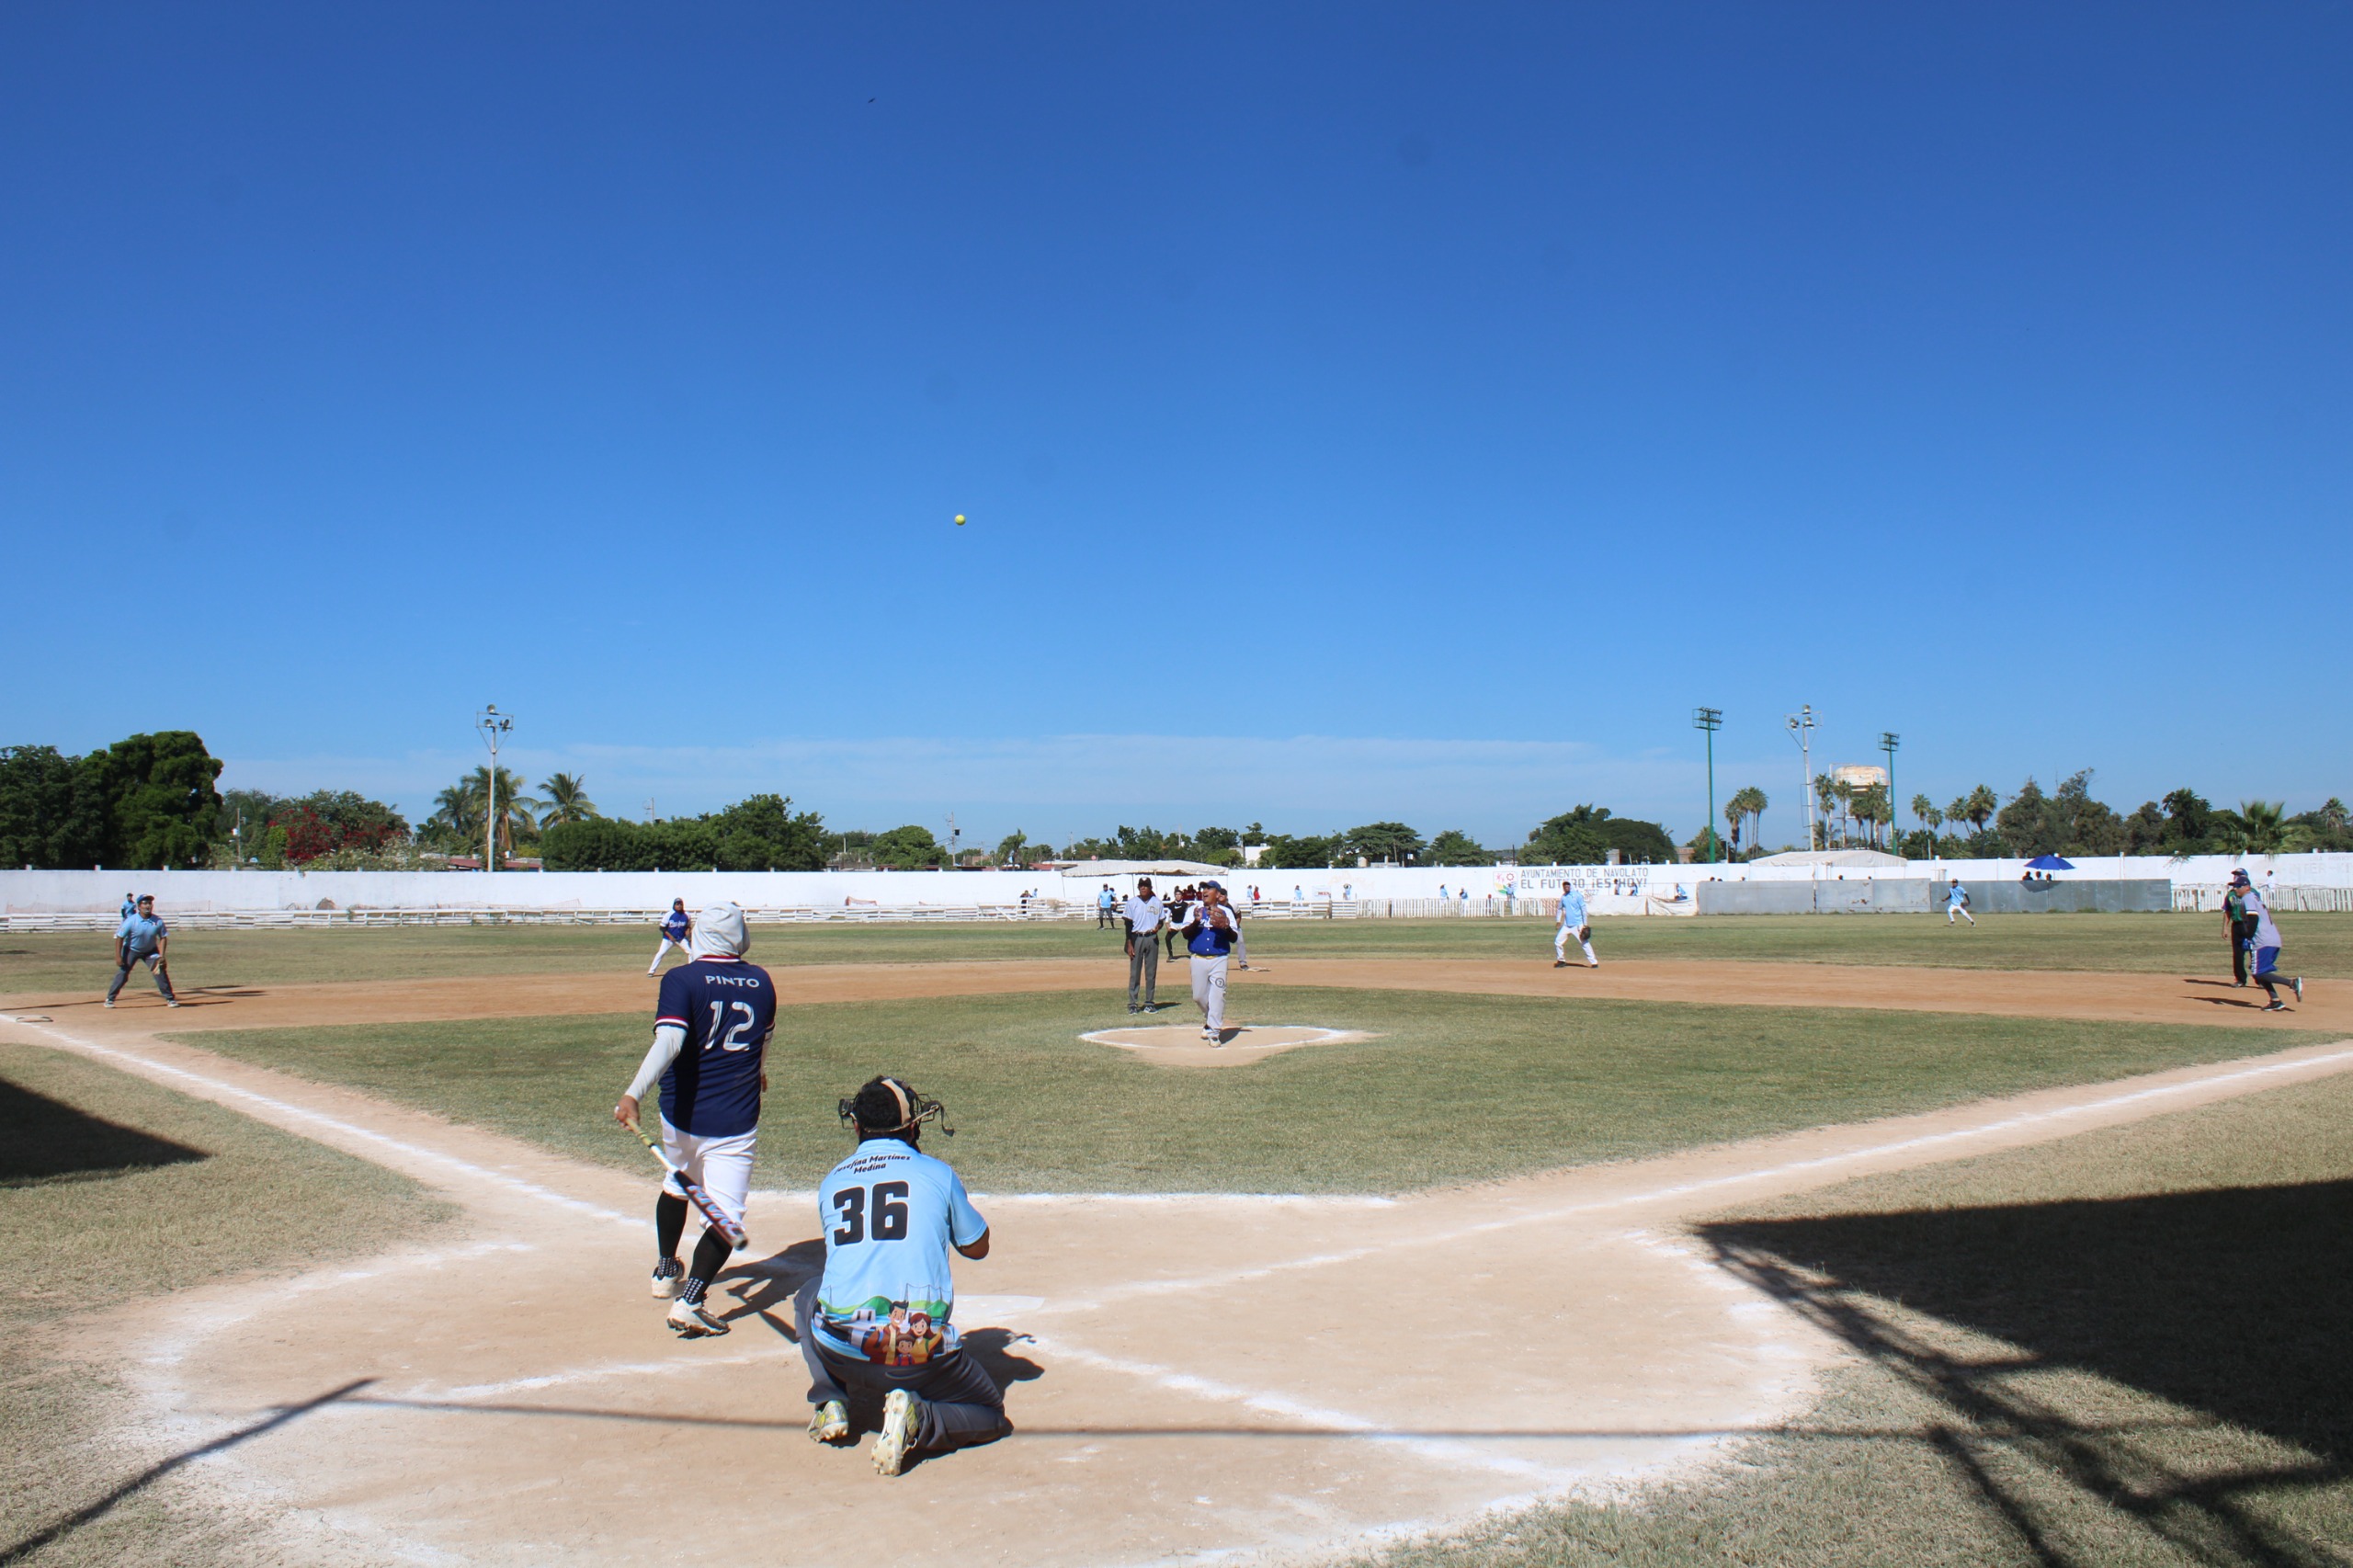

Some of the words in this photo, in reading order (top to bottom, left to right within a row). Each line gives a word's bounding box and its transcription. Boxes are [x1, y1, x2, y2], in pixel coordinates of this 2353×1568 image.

[1520, 869, 1581, 878] AYUNTAMIENTO
[1586, 869, 1597, 878] DE
[1604, 868, 1649, 877] NAVOLATO
[1521, 879, 1534, 889] EL
[1540, 879, 1586, 889] FUTRO
[704, 975, 760, 988] PINTO
[704, 1000, 755, 1051] 12
[853, 1163, 887, 1175] Medina
[833, 1180, 910, 1247] 36
